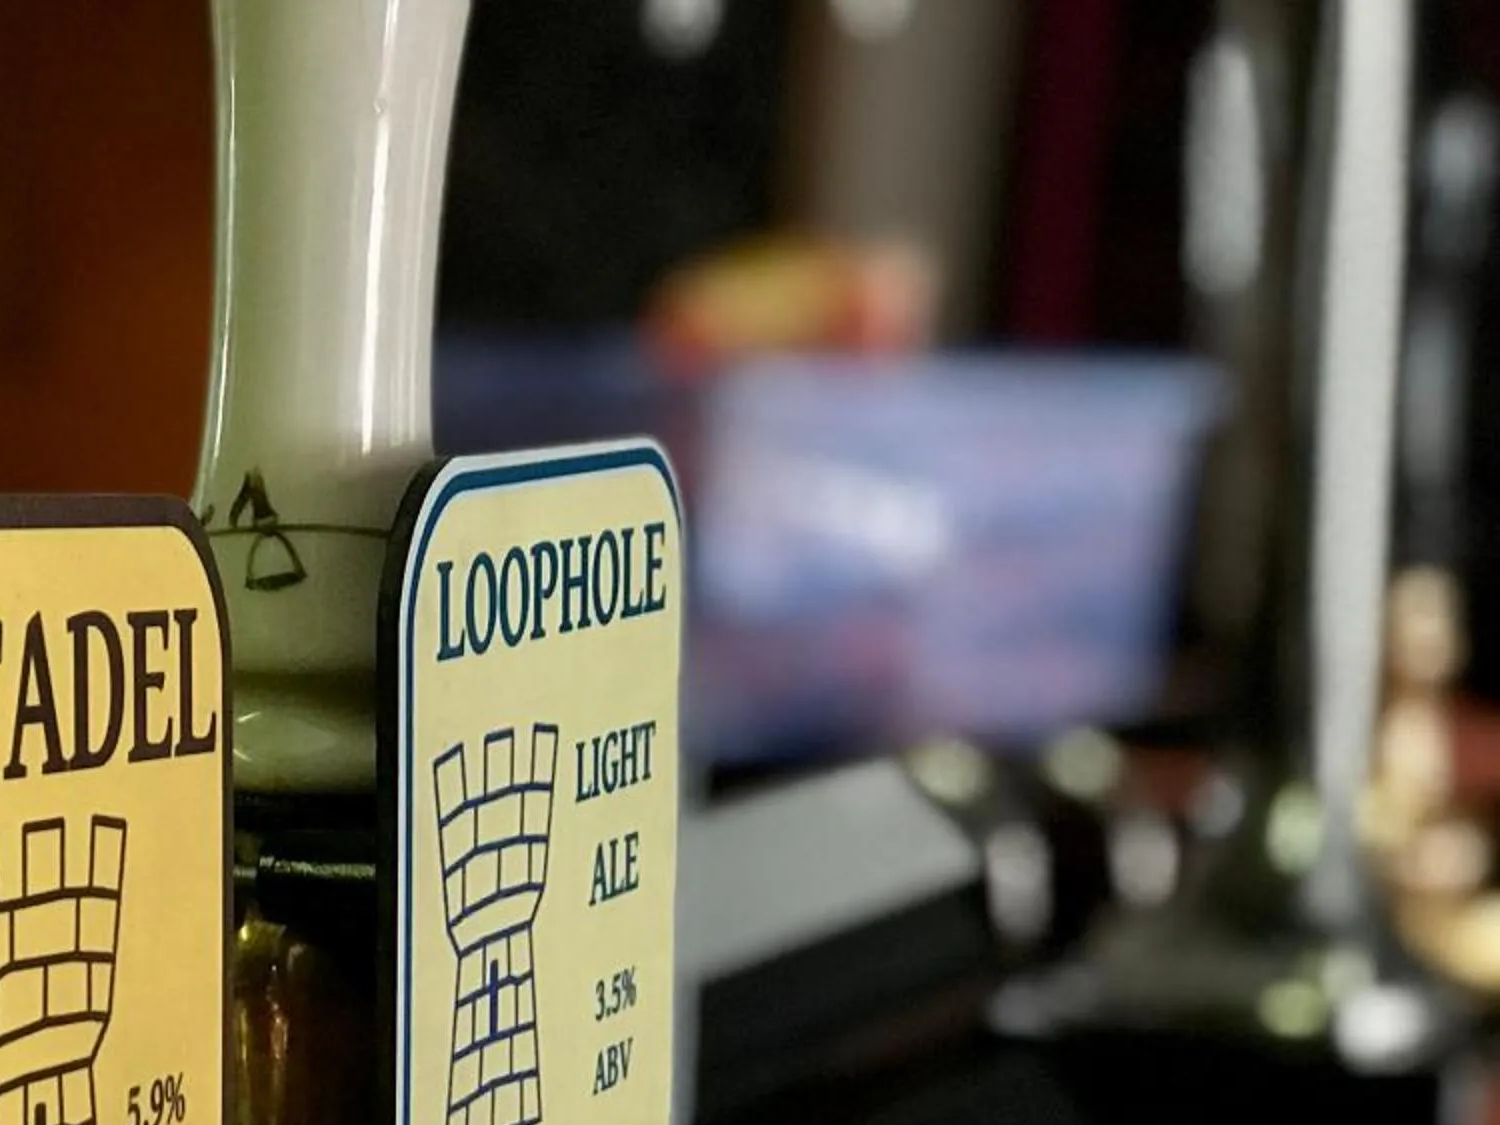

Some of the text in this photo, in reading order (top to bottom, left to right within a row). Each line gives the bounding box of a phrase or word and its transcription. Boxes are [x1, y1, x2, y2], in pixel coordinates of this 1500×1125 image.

[437, 522, 667, 662] LOOPHOLE
[575, 721, 656, 802] LIGHT
[589, 832, 639, 907] ALE
[595, 966, 638, 1021] 3.5%
[593, 1038, 634, 1095] ABV
